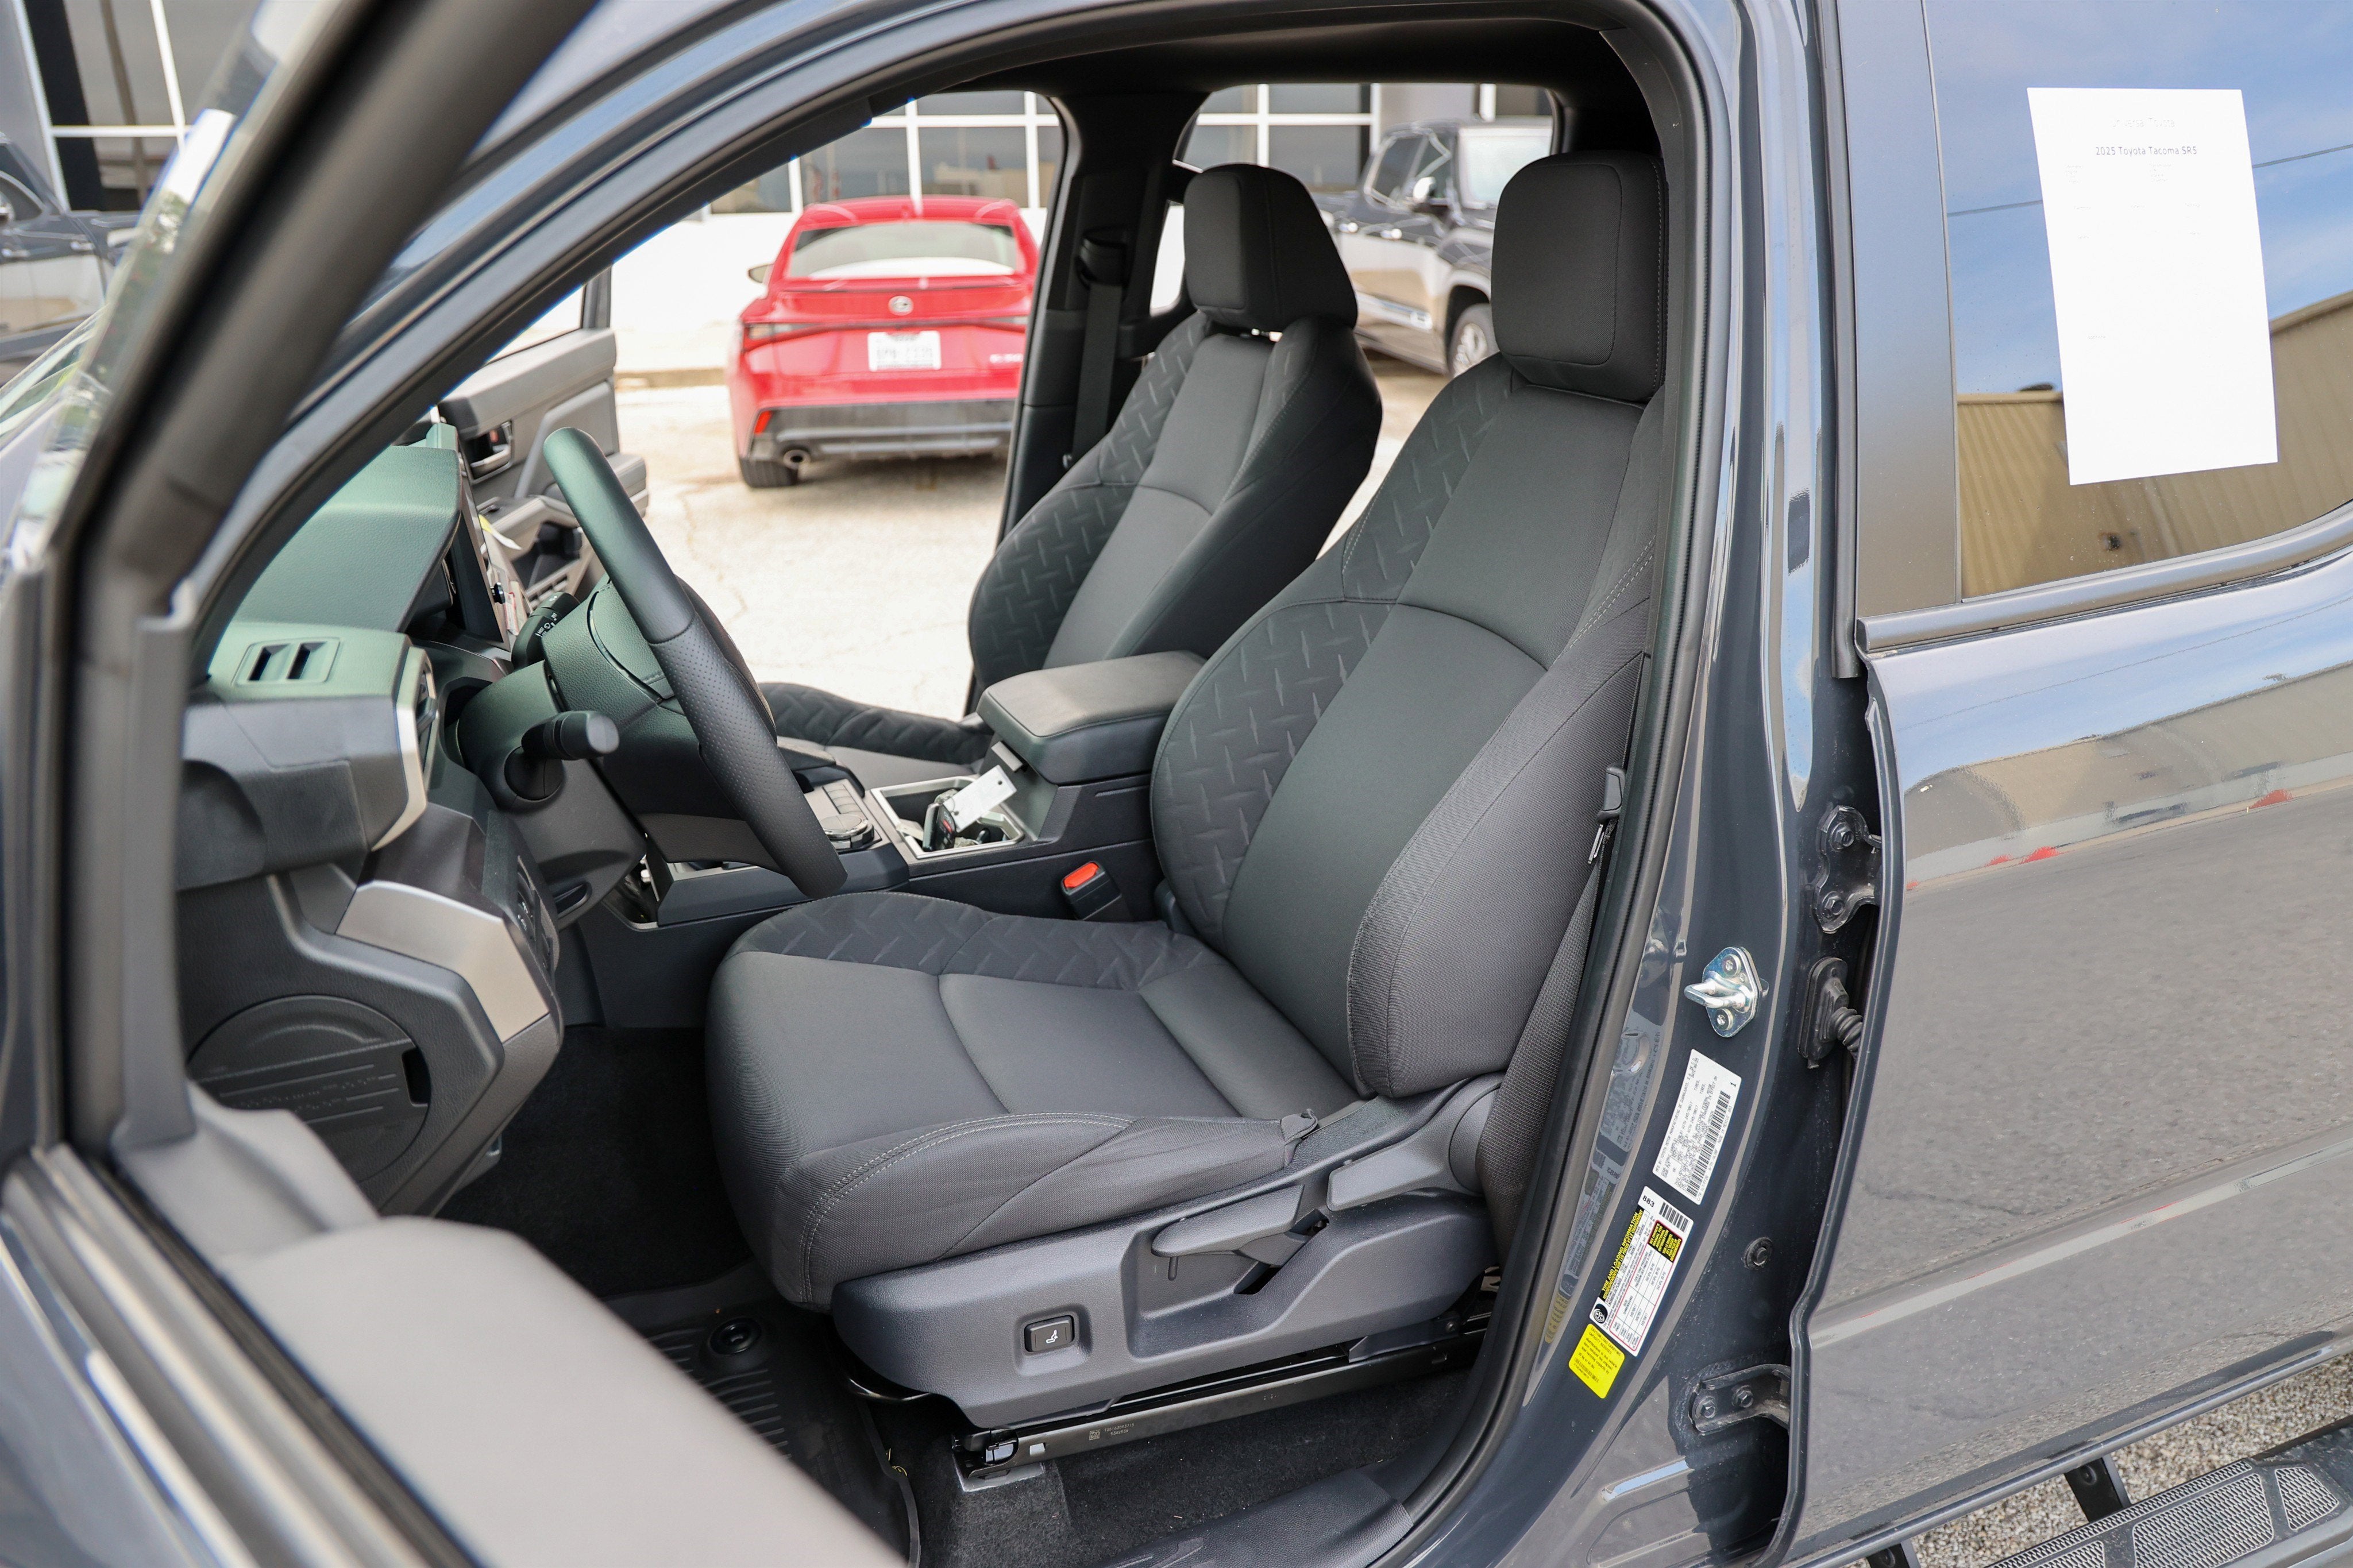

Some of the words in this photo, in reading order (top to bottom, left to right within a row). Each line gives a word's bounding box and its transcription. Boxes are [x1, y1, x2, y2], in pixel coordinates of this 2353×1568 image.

[2096, 146, 2116, 155] 2025
[2118, 146, 2146, 157] Toyota
[2148, 146, 2180, 155] Tacoma
[2181, 146, 2197, 155] SR5
[1641, 1194, 1655, 1208] 883
[1630, 1209, 1644, 1234] CHARGEMENT
[1606, 1267, 1614, 1280] AND
[1611, 1245, 1624, 1269] LOADING
[1621, 1211, 1638, 1247] INFORMATION
[1591, 1326, 1602, 1338] CAUTION
[1588, 1331, 1600, 1343] CAPACITY
[1600, 1342, 1612, 1354] REDUCED
